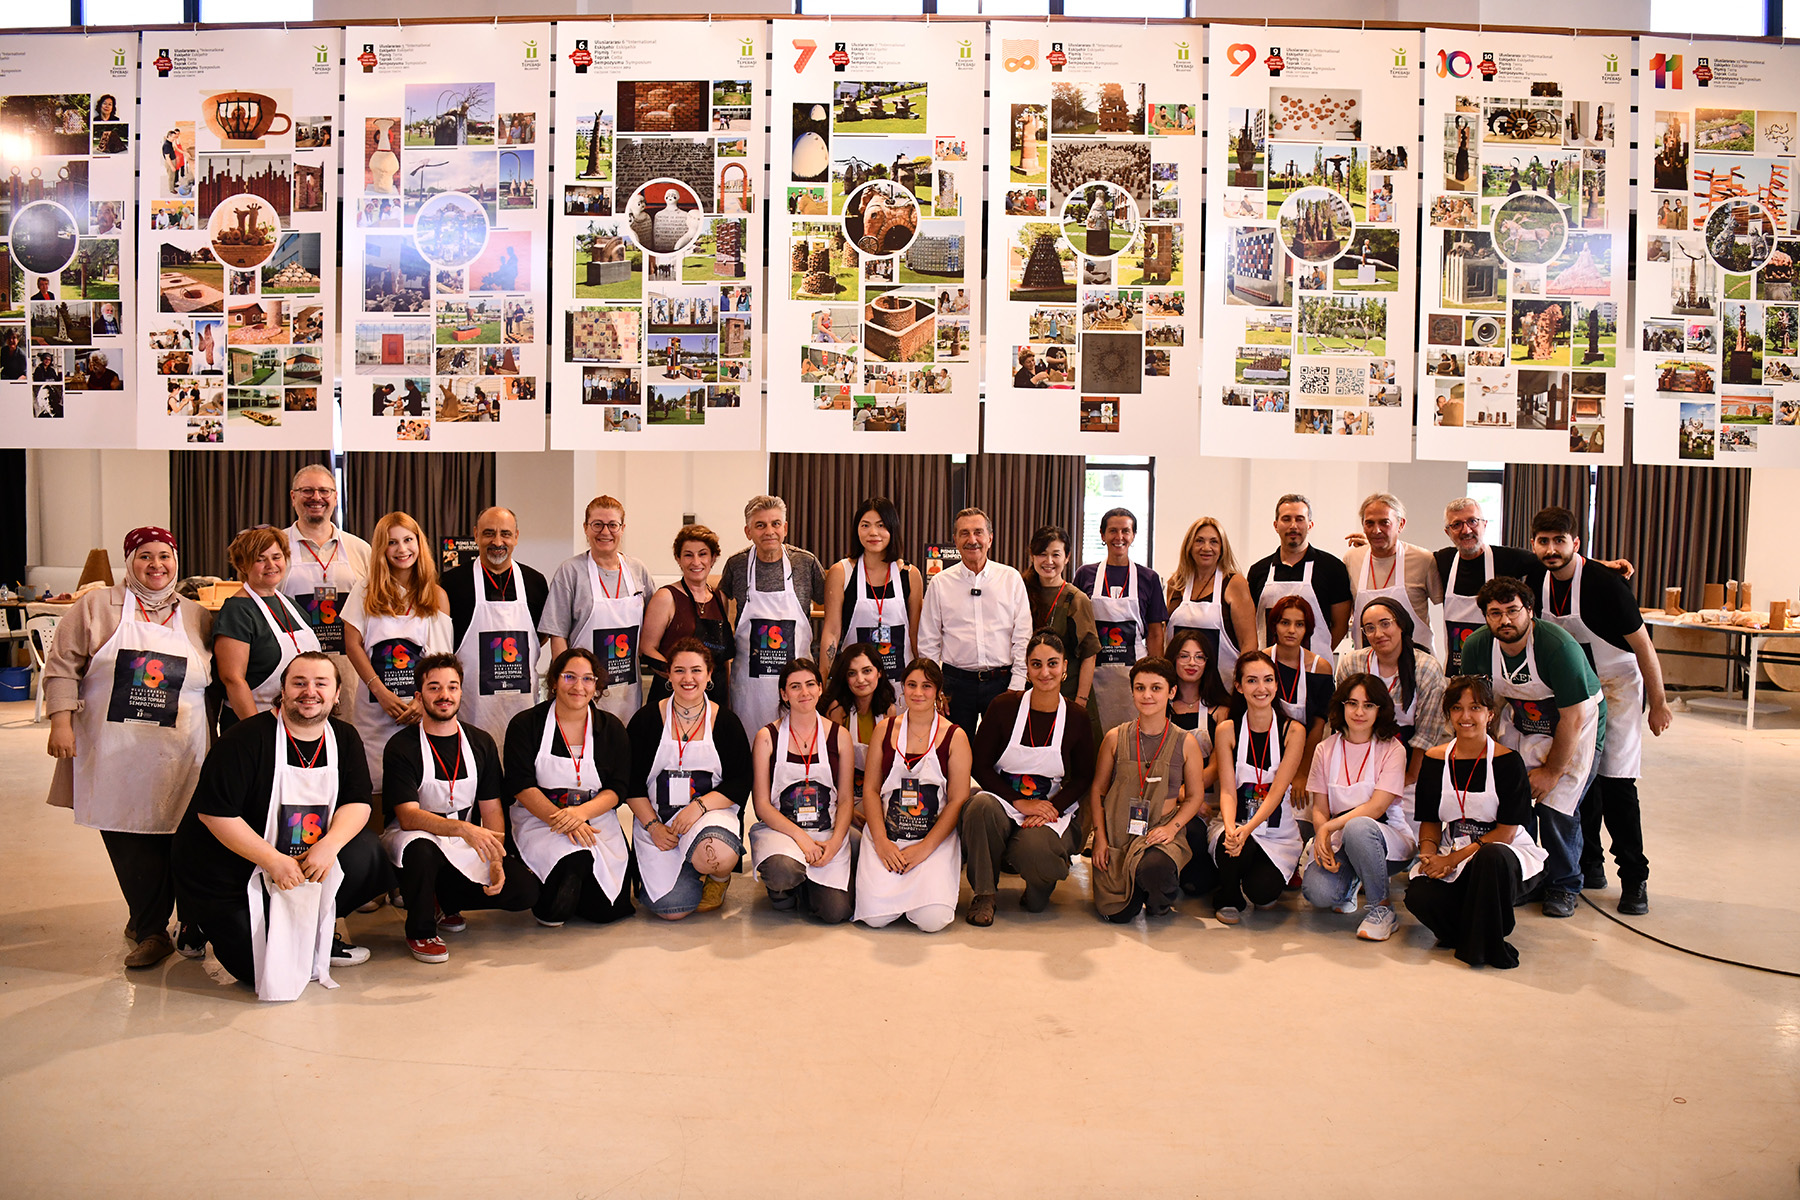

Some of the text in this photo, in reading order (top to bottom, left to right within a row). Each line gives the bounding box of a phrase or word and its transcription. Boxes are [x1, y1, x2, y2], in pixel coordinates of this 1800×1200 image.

[792, 39, 817, 74] 7
[1227, 43, 1256, 77] 9
[1649, 53, 1682, 90] 11
